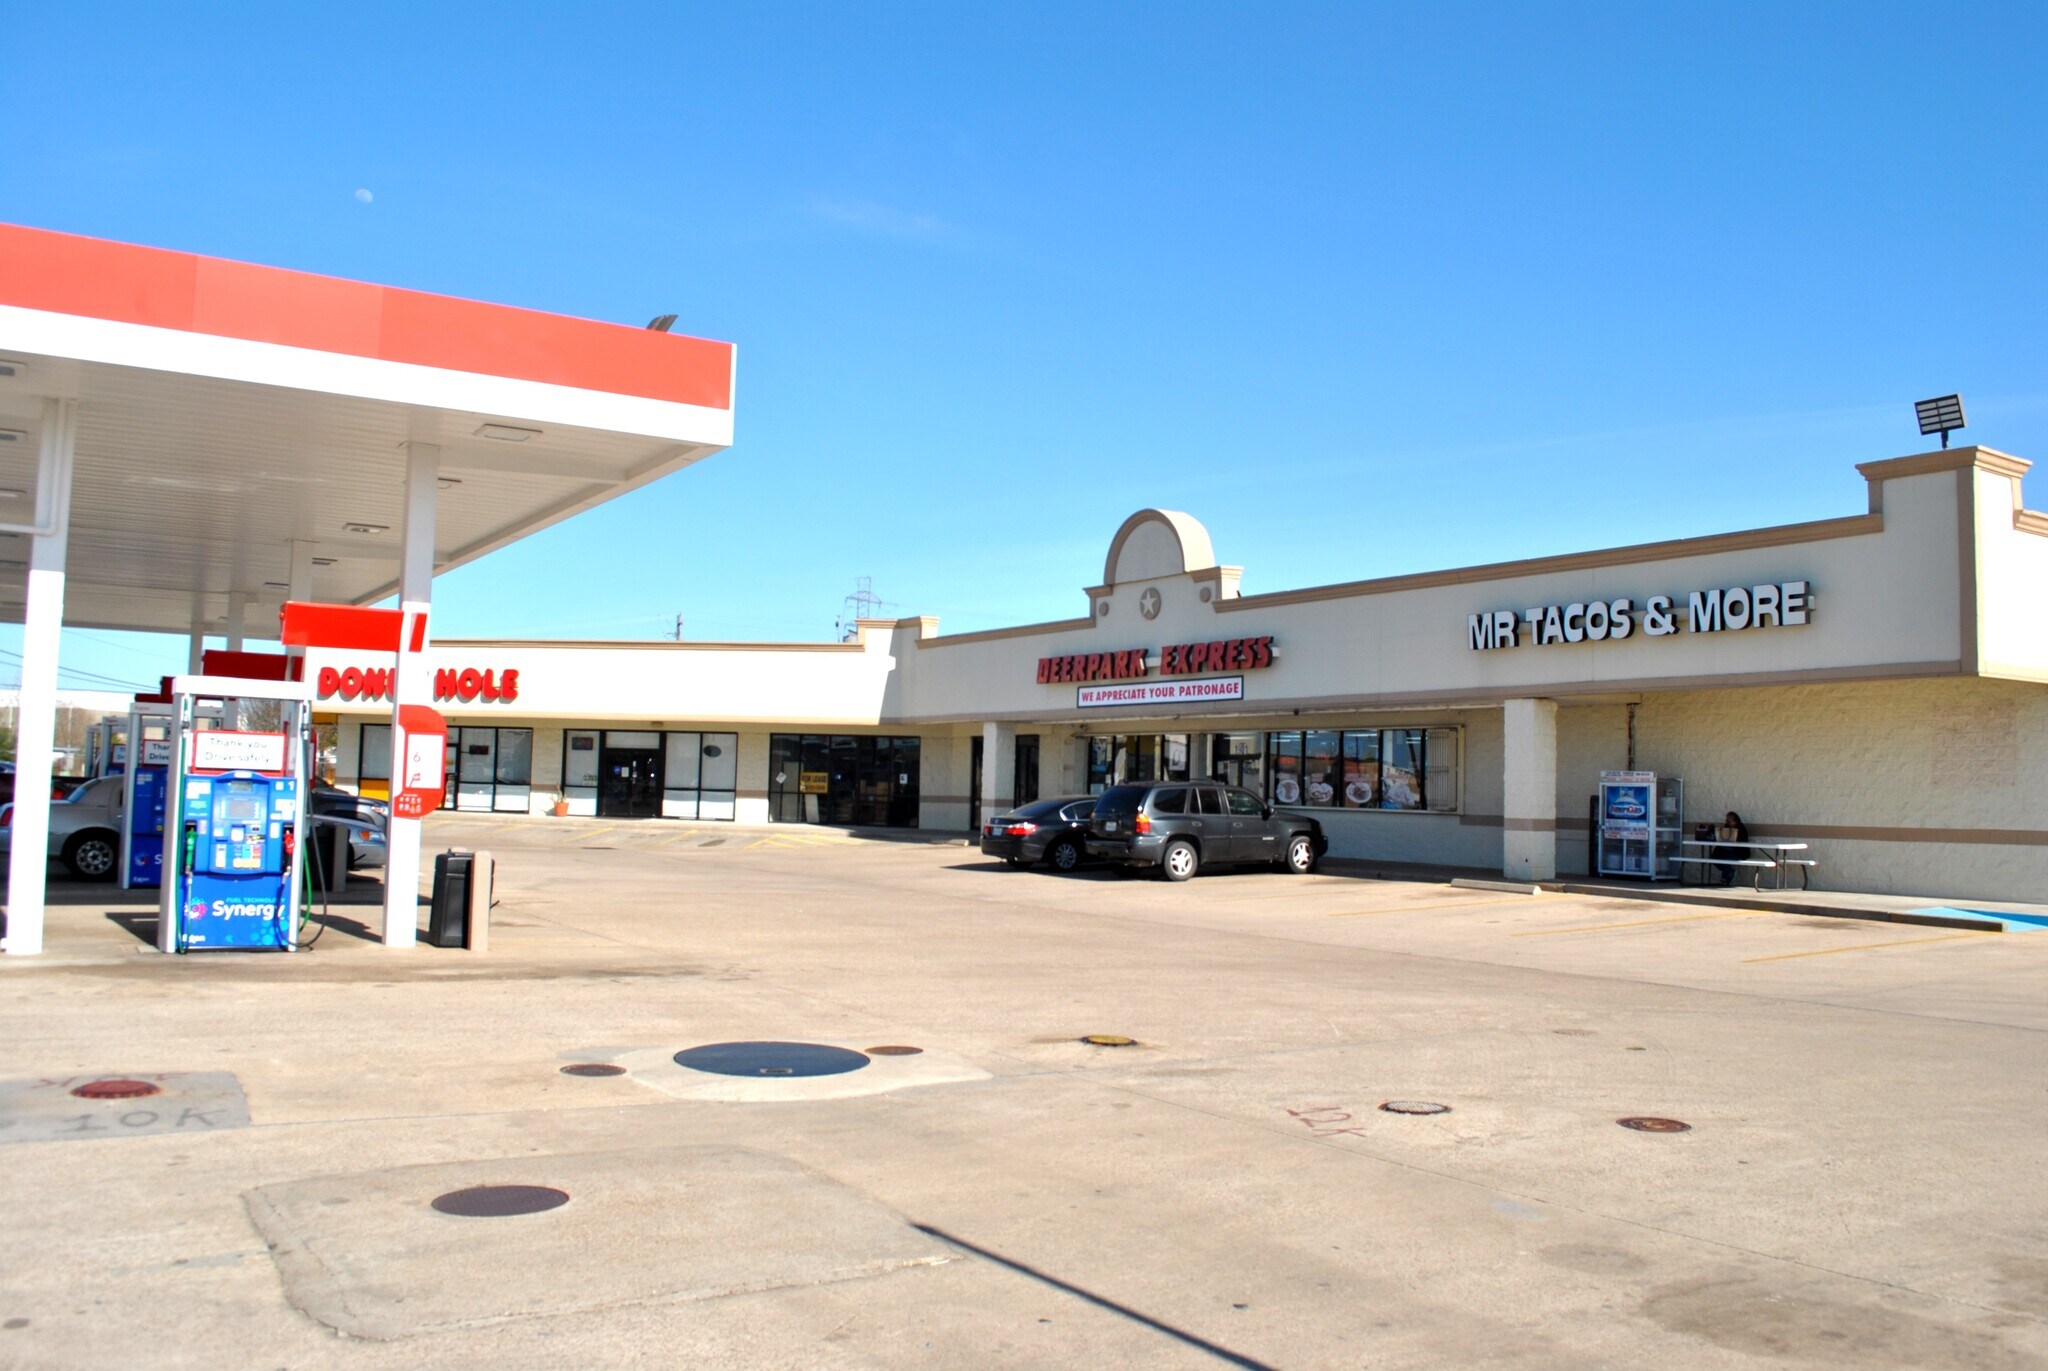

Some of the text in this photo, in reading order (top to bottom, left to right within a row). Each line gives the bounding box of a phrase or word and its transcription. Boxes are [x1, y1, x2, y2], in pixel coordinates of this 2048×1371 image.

[1468, 580, 1810, 650] MR TACOS & MORE
[1037, 636, 1274, 684] DEERPARK EXPRESS
[318, 666, 519, 699] DON HOLE
[1081, 682, 1239, 702] WE APPRECIATE YOUR PATRONAGE
[413, 752, 421, 763] 6
[52, 1107, 227, 1133] 10K
